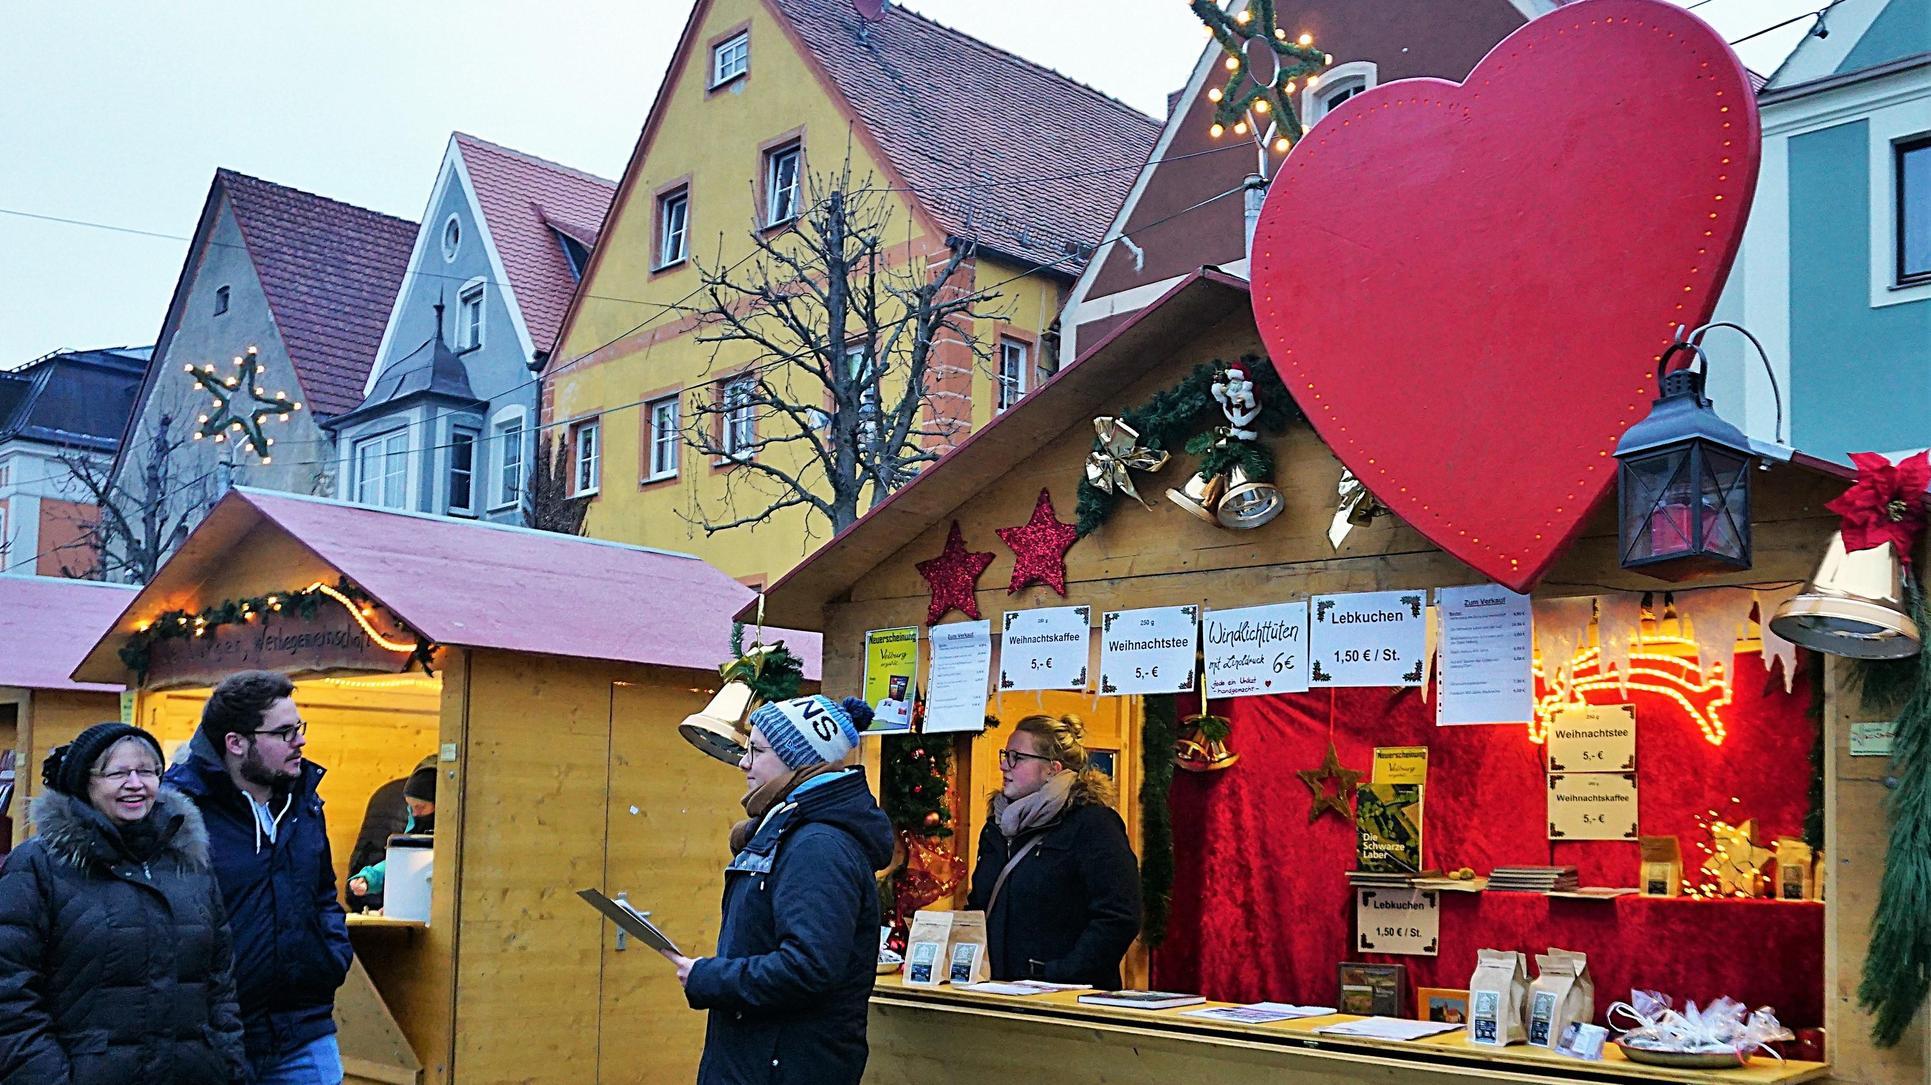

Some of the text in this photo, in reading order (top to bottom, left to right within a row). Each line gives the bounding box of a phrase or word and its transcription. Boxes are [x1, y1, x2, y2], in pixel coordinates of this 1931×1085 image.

[1464, 597, 1506, 607] Zum Verkauf
[1331, 609, 1404, 625] Lebkuchen
[869, 632, 917, 645] Neuerscheinung
[1009, 633, 1080, 645] Weihnachtskaffee
[1208, 620, 1299, 648] Windlichttüten
[1108, 637, 1189, 652] Weihnachtstee
[1334, 649, 1359, 664] 1,50
[1362, 649, 1371, 662] €
[1382, 648, 1401, 662] St.
[1046, 657, 1053, 669] €
[1208, 656, 1221, 676] mit
[1151, 666, 1159, 678] €
[789, 698, 838, 742] NS
[1555, 728, 1629, 739] Weihnachtstee
[1597, 750, 1604, 760] €
[1556, 794, 1630, 803] Weihnachtskaffee
[1598, 814, 1605, 823] €
[1363, 832, 1378, 842] Die
[1363, 841, 1405, 852] Schwarze
[1363, 850, 1388, 860] Laber
[1373, 899, 1425, 911] Lebkuchen
[1396, 927, 1403, 937] €
[1410, 927, 1422, 938] St.
